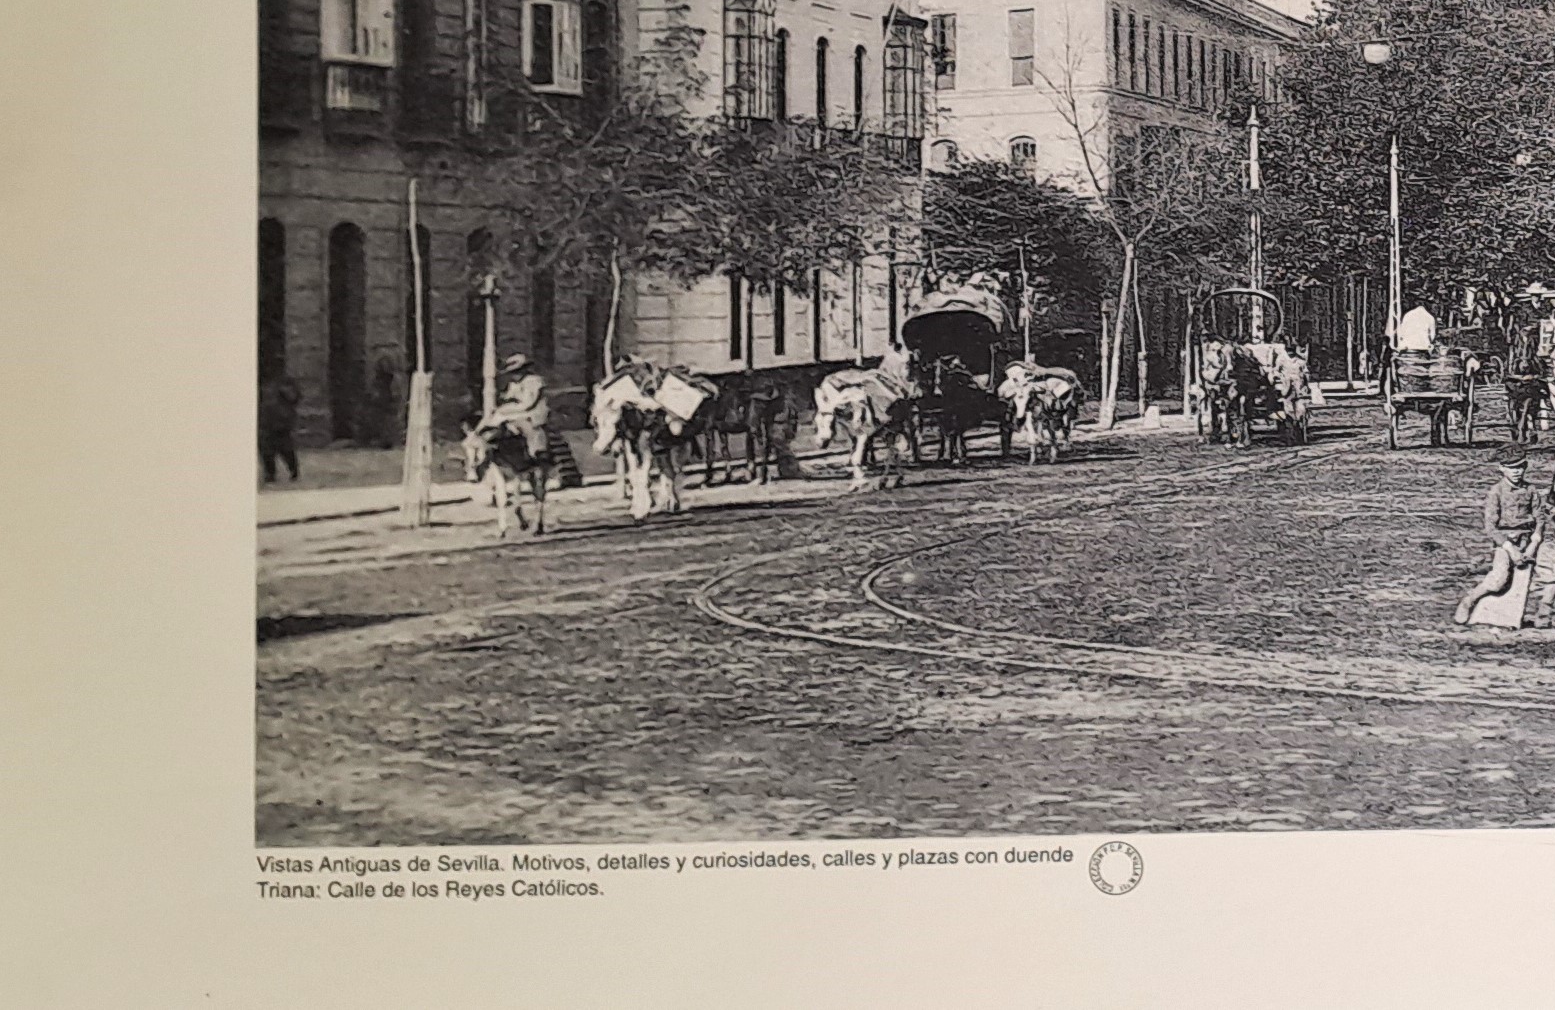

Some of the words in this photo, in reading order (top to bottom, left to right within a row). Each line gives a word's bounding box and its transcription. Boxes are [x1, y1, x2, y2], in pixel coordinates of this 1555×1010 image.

[256, 854, 315, 874] Vistas
[318, 854, 402, 876] Antiguas
[407, 854, 431, 873] de
[437, 854, 506, 873] Sevilla.
[512, 853, 591, 874] Motivos,
[596, 852, 671, 871] detalles
[675, 856, 687, 874] y
[691, 850, 818, 870] curiosidades,
[822, 850, 877, 867] calles
[881, 852, 893, 871] y
[898, 850, 960, 870] plazas
[964, 850, 999, 865] con
[1004, 847, 1074, 864] duende
[256, 880, 321, 899] Triana:
[327, 880, 377, 899] Calle
[382, 881, 406, 899] de
[411, 880, 440, 898] los
[445, 879, 506, 902] Reyes
[511, 877, 605, 897] Católicos.
